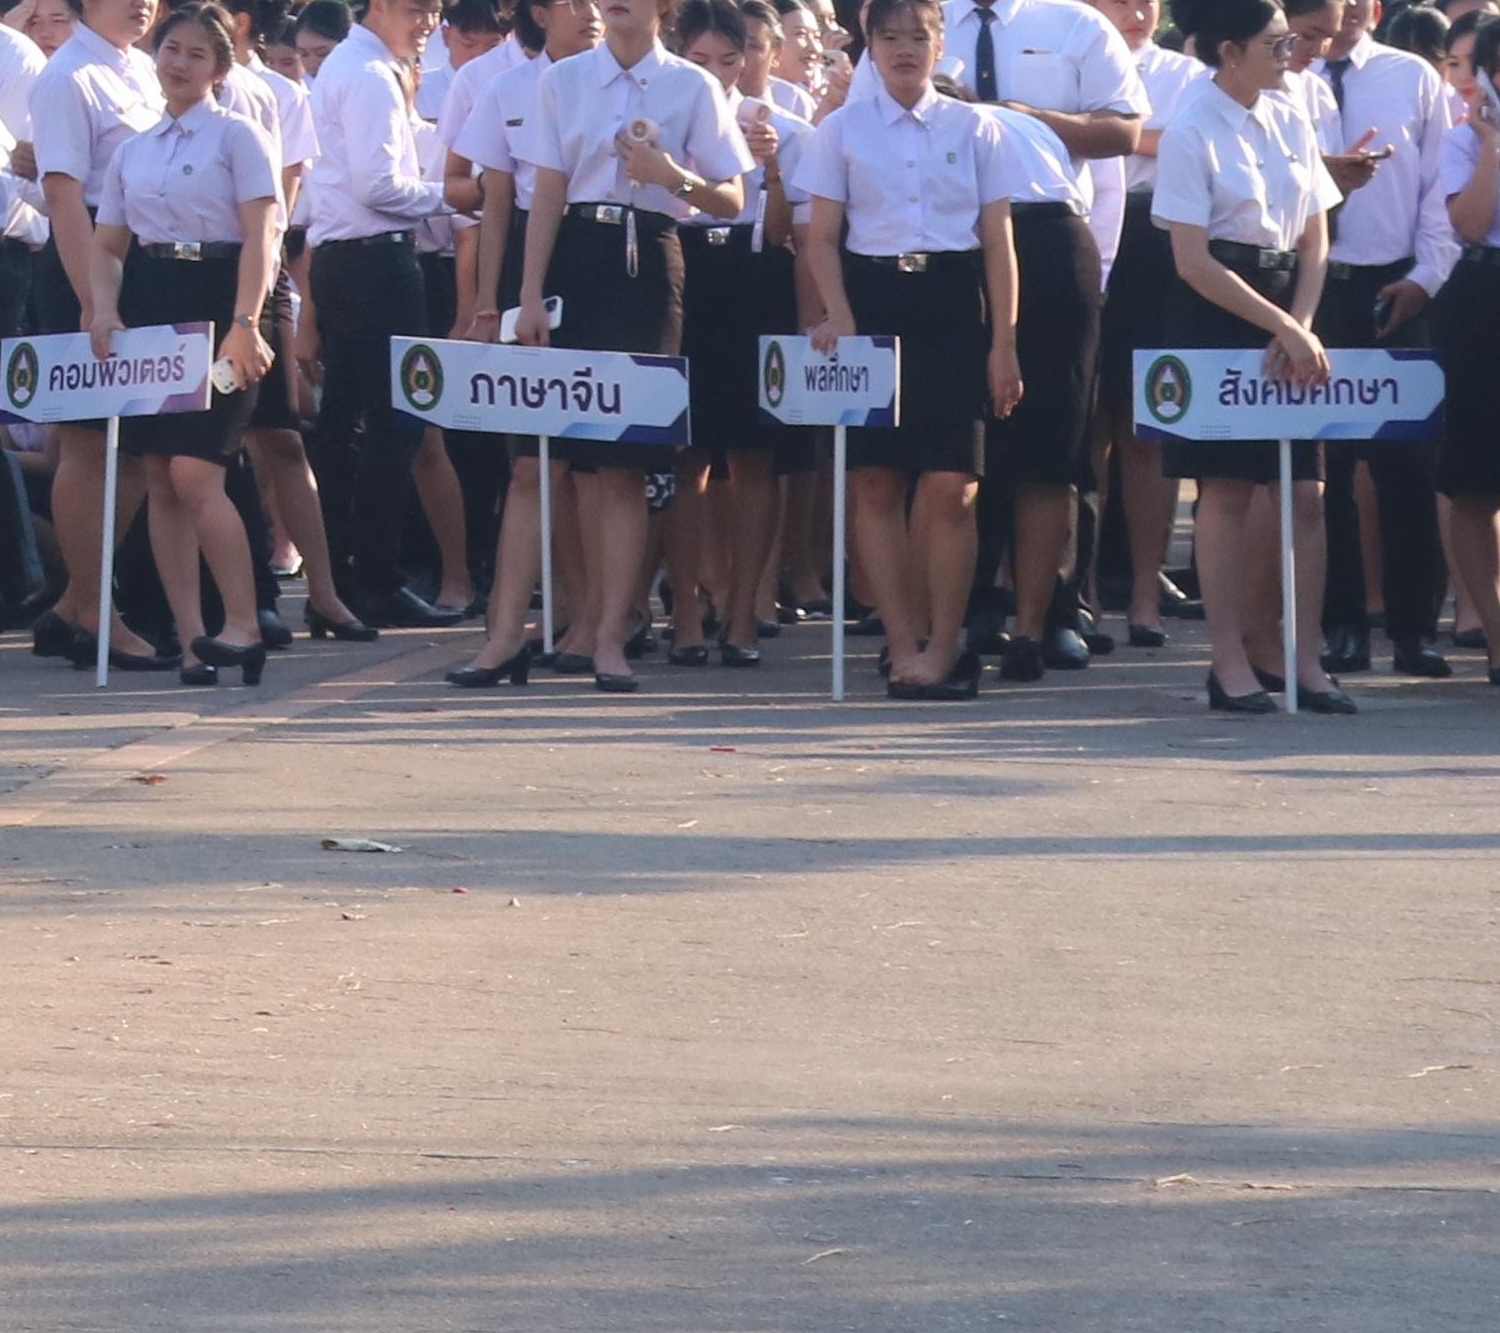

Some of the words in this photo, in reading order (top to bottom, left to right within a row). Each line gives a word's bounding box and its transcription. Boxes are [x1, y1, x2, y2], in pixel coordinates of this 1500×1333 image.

[470, 366, 621, 415] ภาษาจีน
[804, 352, 869, 393] พลศึกษา
